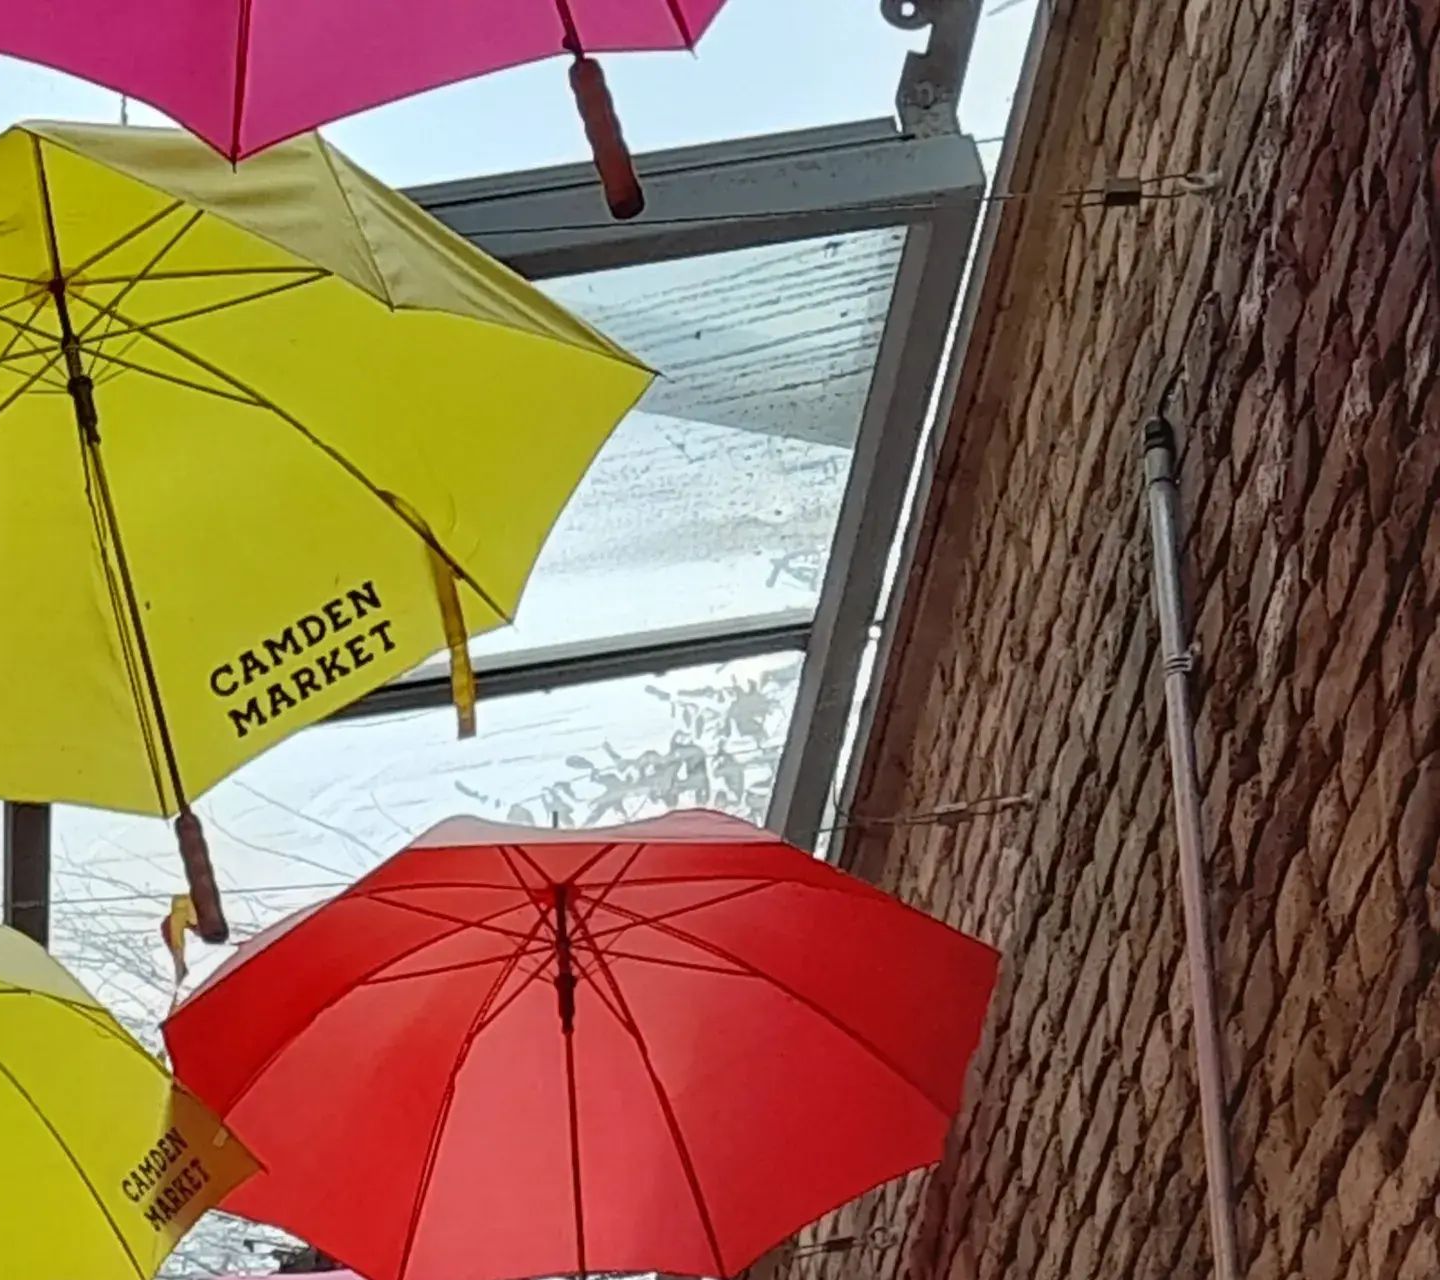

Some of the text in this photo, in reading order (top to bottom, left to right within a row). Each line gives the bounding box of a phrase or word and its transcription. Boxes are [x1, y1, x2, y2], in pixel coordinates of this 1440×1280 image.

[210, 580, 383, 697] CAMDEN
[228, 621, 397, 738] MARKET
[122, 1127, 188, 1204] CAMDEN
[143, 1158, 211, 1232] MARKET
